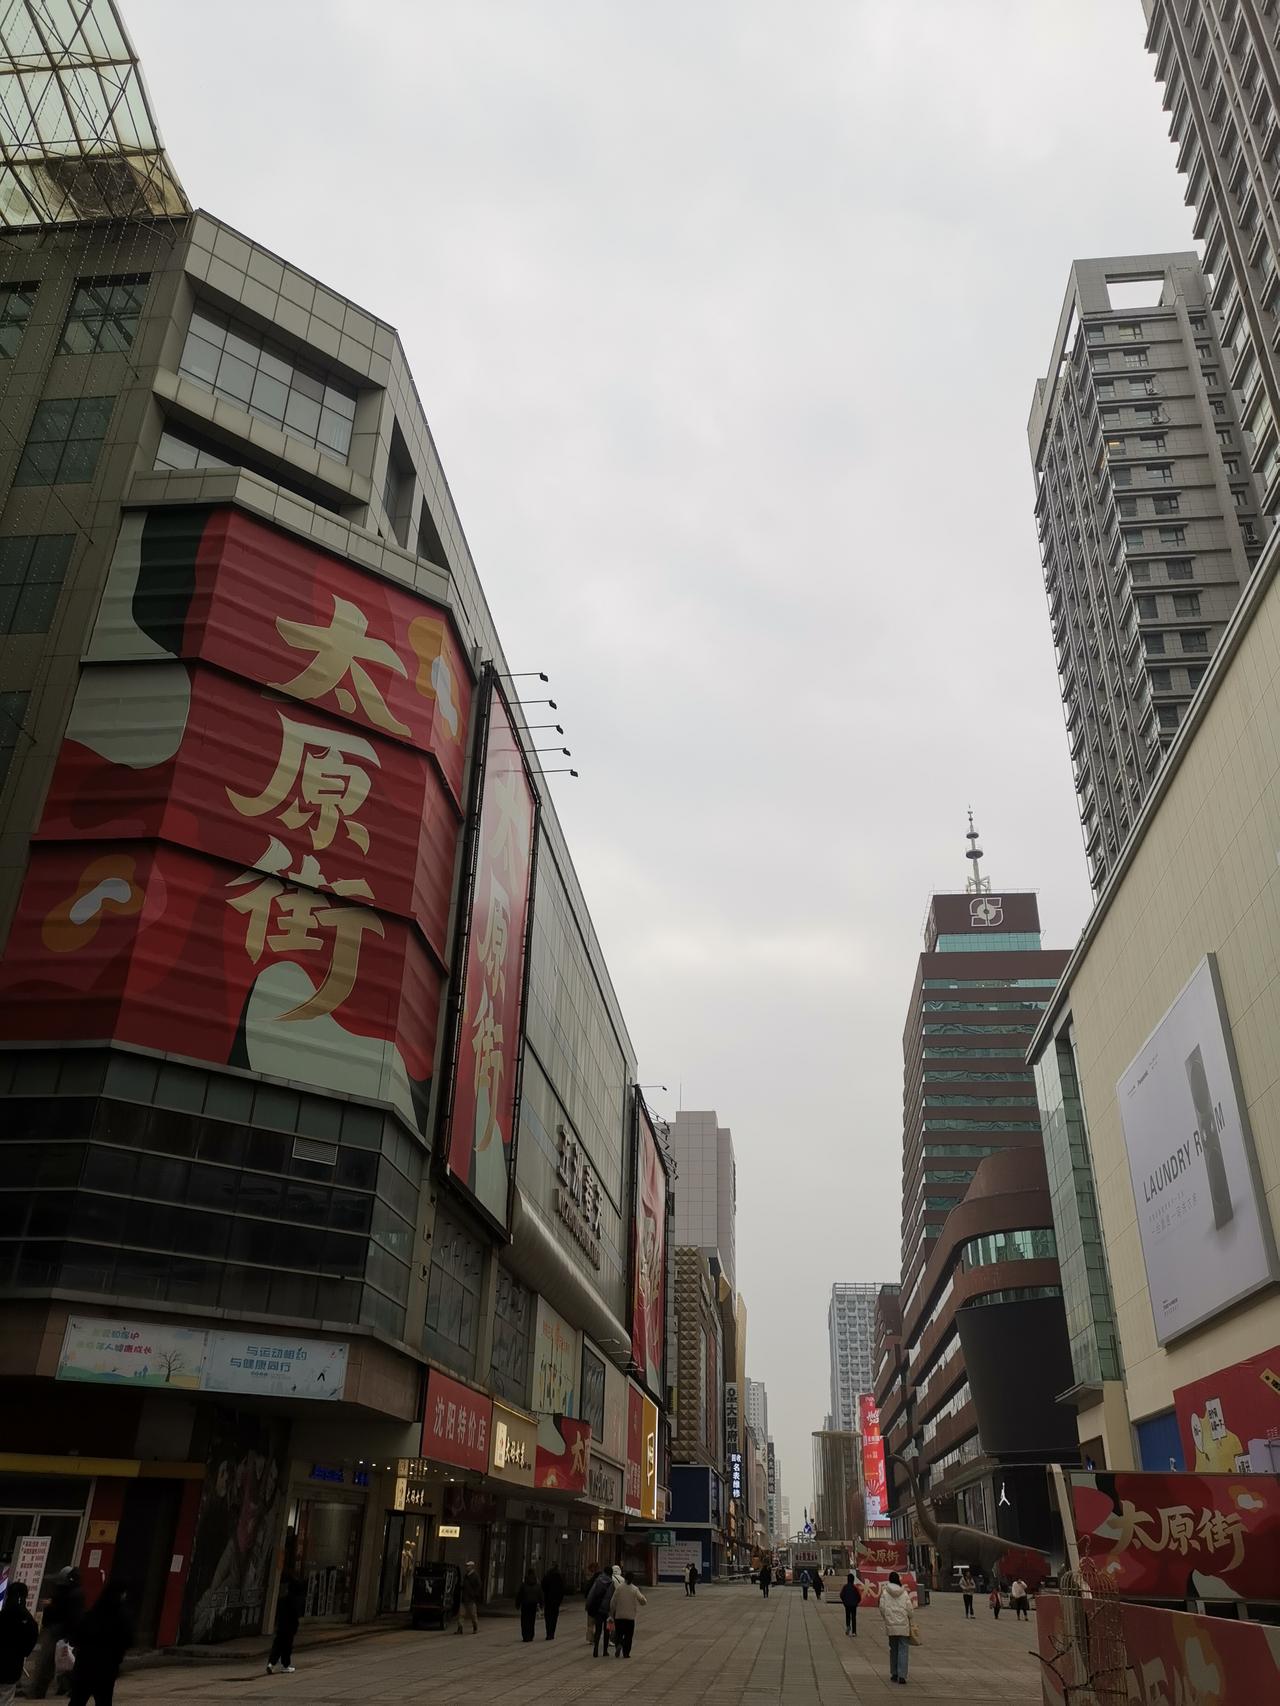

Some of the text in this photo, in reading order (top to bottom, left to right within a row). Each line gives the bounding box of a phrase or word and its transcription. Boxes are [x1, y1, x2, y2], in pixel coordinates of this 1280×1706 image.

[225, 594, 413, 1022] 太原街
[473, 771, 531, 1153] 太原街
[1143, 1140, 1192, 1204] LAUNDRY
[1193, 1101, 1226, 1157] RM
[229, 1357, 292, 1373] 与健康同行
[246, 1345, 308, 1361] 与运动相约
[433, 1395, 487, 1452] 沈阳特价店
[865, 1547, 900, 1569] 太原街
[1094, 1500, 1249, 1573] 太原街
